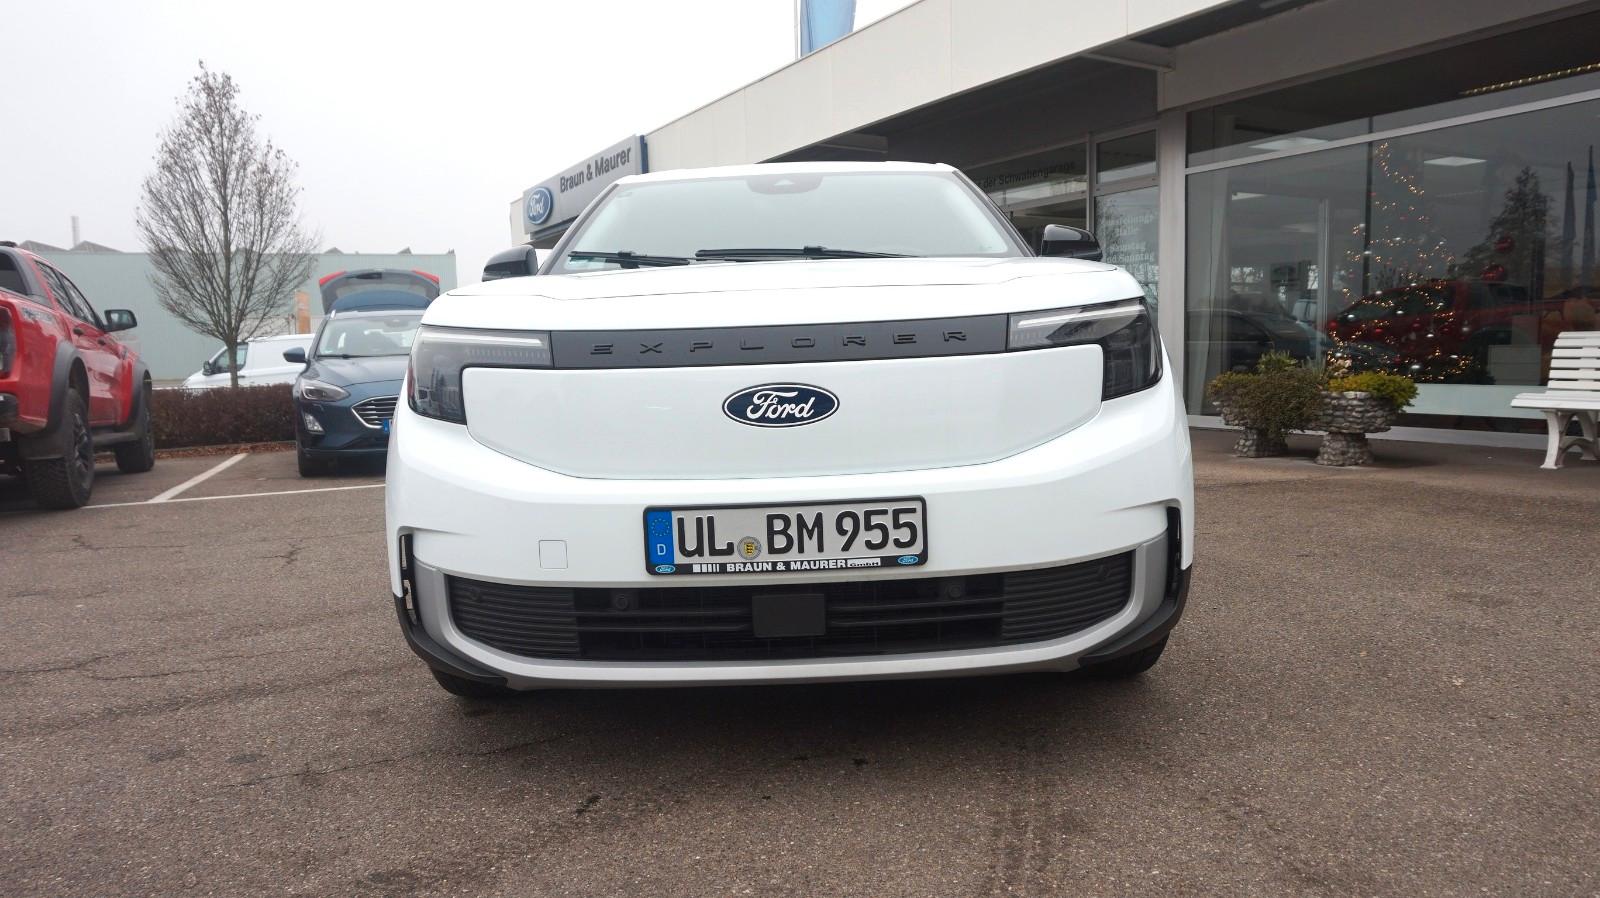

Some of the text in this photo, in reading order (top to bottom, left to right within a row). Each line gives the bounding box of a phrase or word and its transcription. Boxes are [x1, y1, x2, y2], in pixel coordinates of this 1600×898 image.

[560, 146, 632, 193] Braun & Maurer
[589, 331, 968, 355] EXPLORER
[745, 390, 816, 419] Ford
[677, 507, 918, 557] UL BM 955
[656, 543, 667, 555] D
[726, 562, 773, 573] BRAUN
[776, 561, 786, 571] &
[790, 559, 847, 571] MAURER
